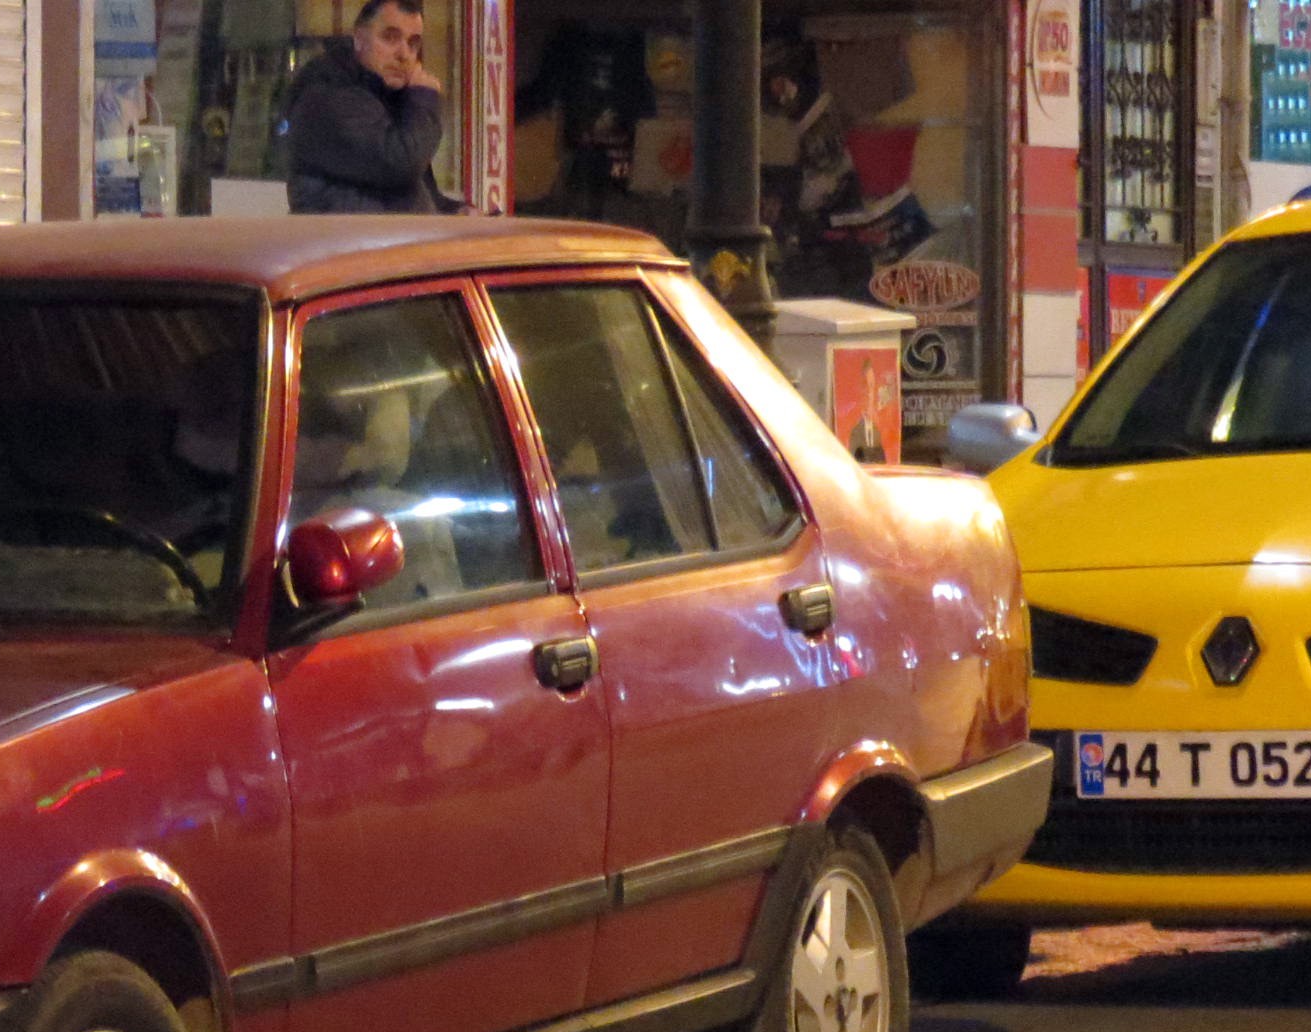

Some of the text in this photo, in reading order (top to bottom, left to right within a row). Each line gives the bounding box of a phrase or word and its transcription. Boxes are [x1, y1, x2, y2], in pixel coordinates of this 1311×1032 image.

[1084, 769, 1102, 784] TR
[1105, 742, 1160, 788] 44
[1179, 742, 1211, 787] T
